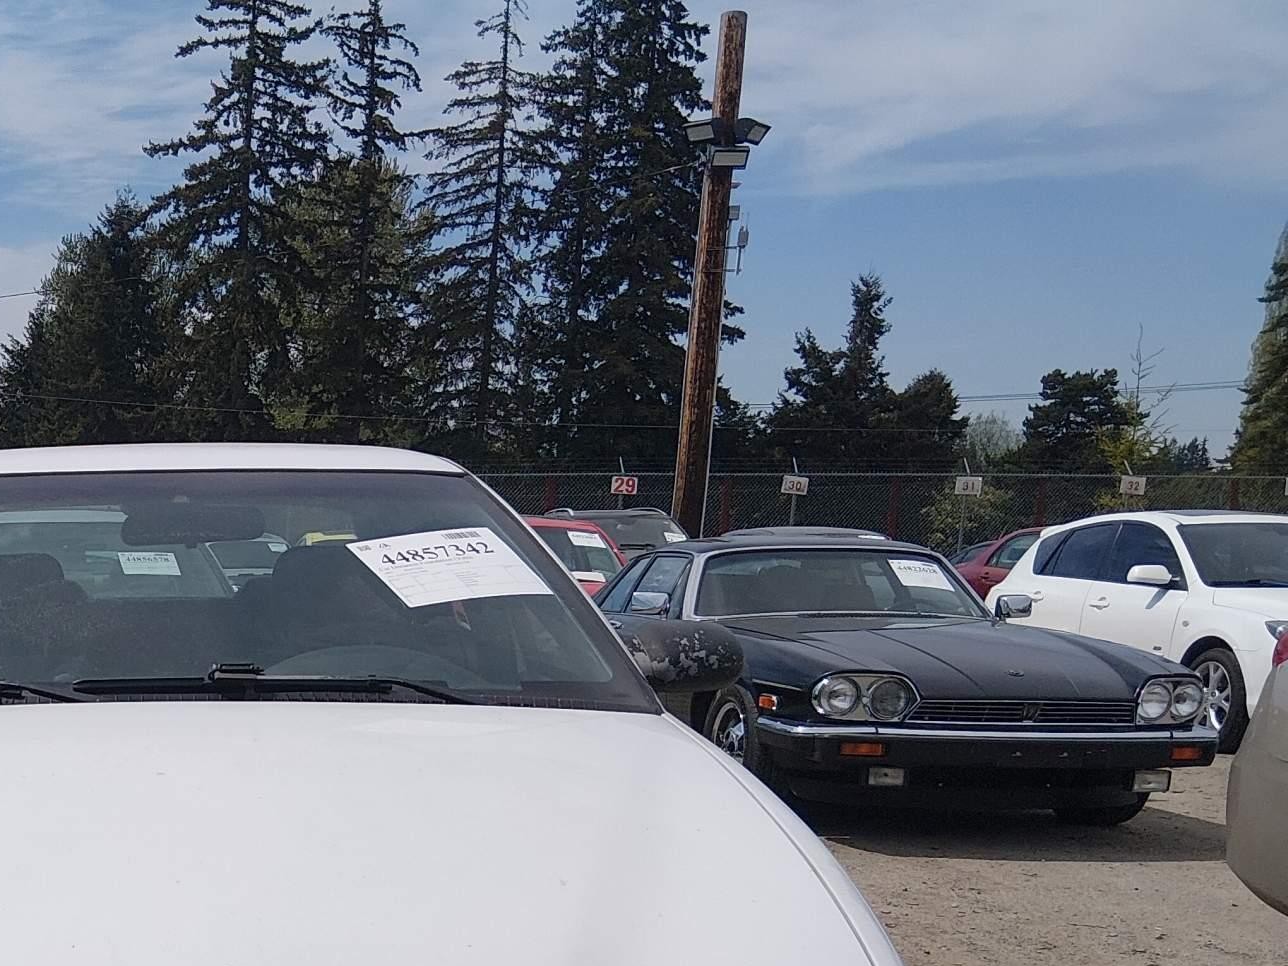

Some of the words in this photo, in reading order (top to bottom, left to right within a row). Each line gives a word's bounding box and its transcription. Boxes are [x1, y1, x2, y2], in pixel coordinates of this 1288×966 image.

[613, 477, 636, 494] 29
[789, 480, 802, 492] 30
[962, 481, 975, 491] 31
[1127, 481, 1140, 491] 32
[381, 541, 494, 565] 44857342
